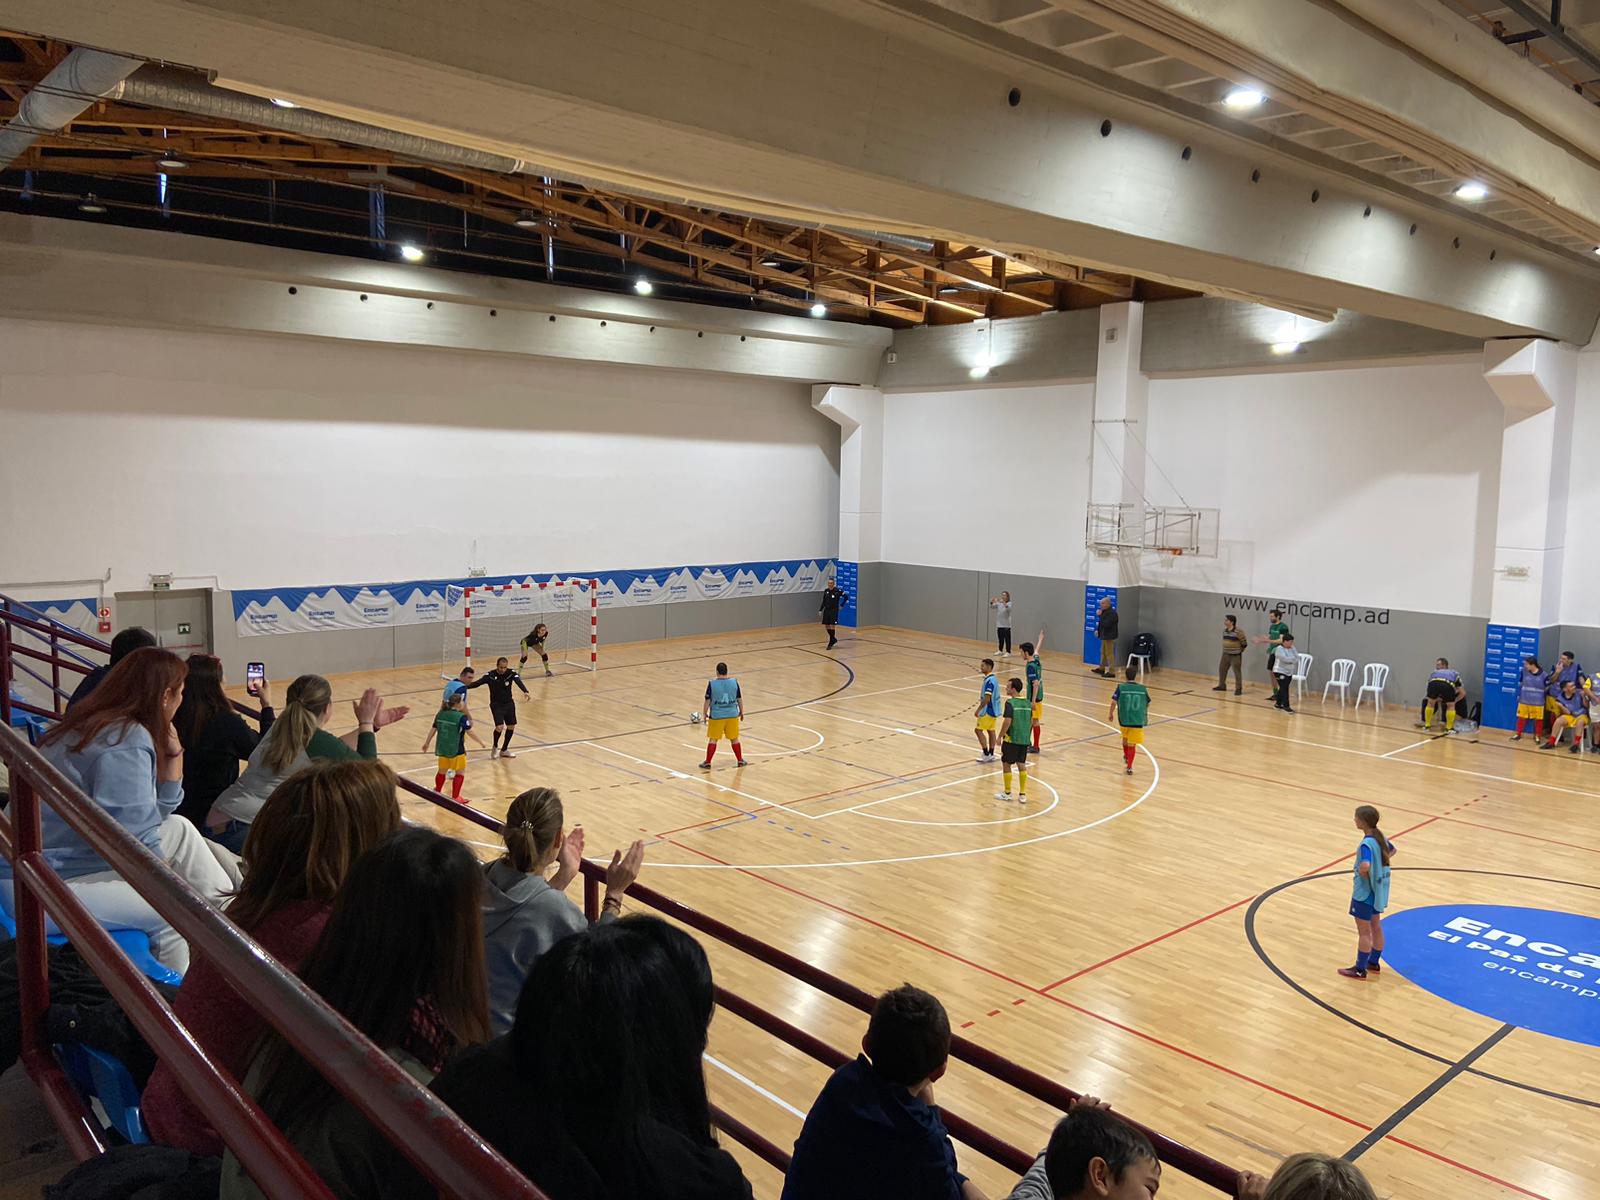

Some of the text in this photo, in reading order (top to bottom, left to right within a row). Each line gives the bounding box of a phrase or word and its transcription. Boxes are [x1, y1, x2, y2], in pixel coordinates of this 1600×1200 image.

[1224, 596, 1390, 625] wwwencamp.ad
[1427, 930, 1585, 979] El Pas de
